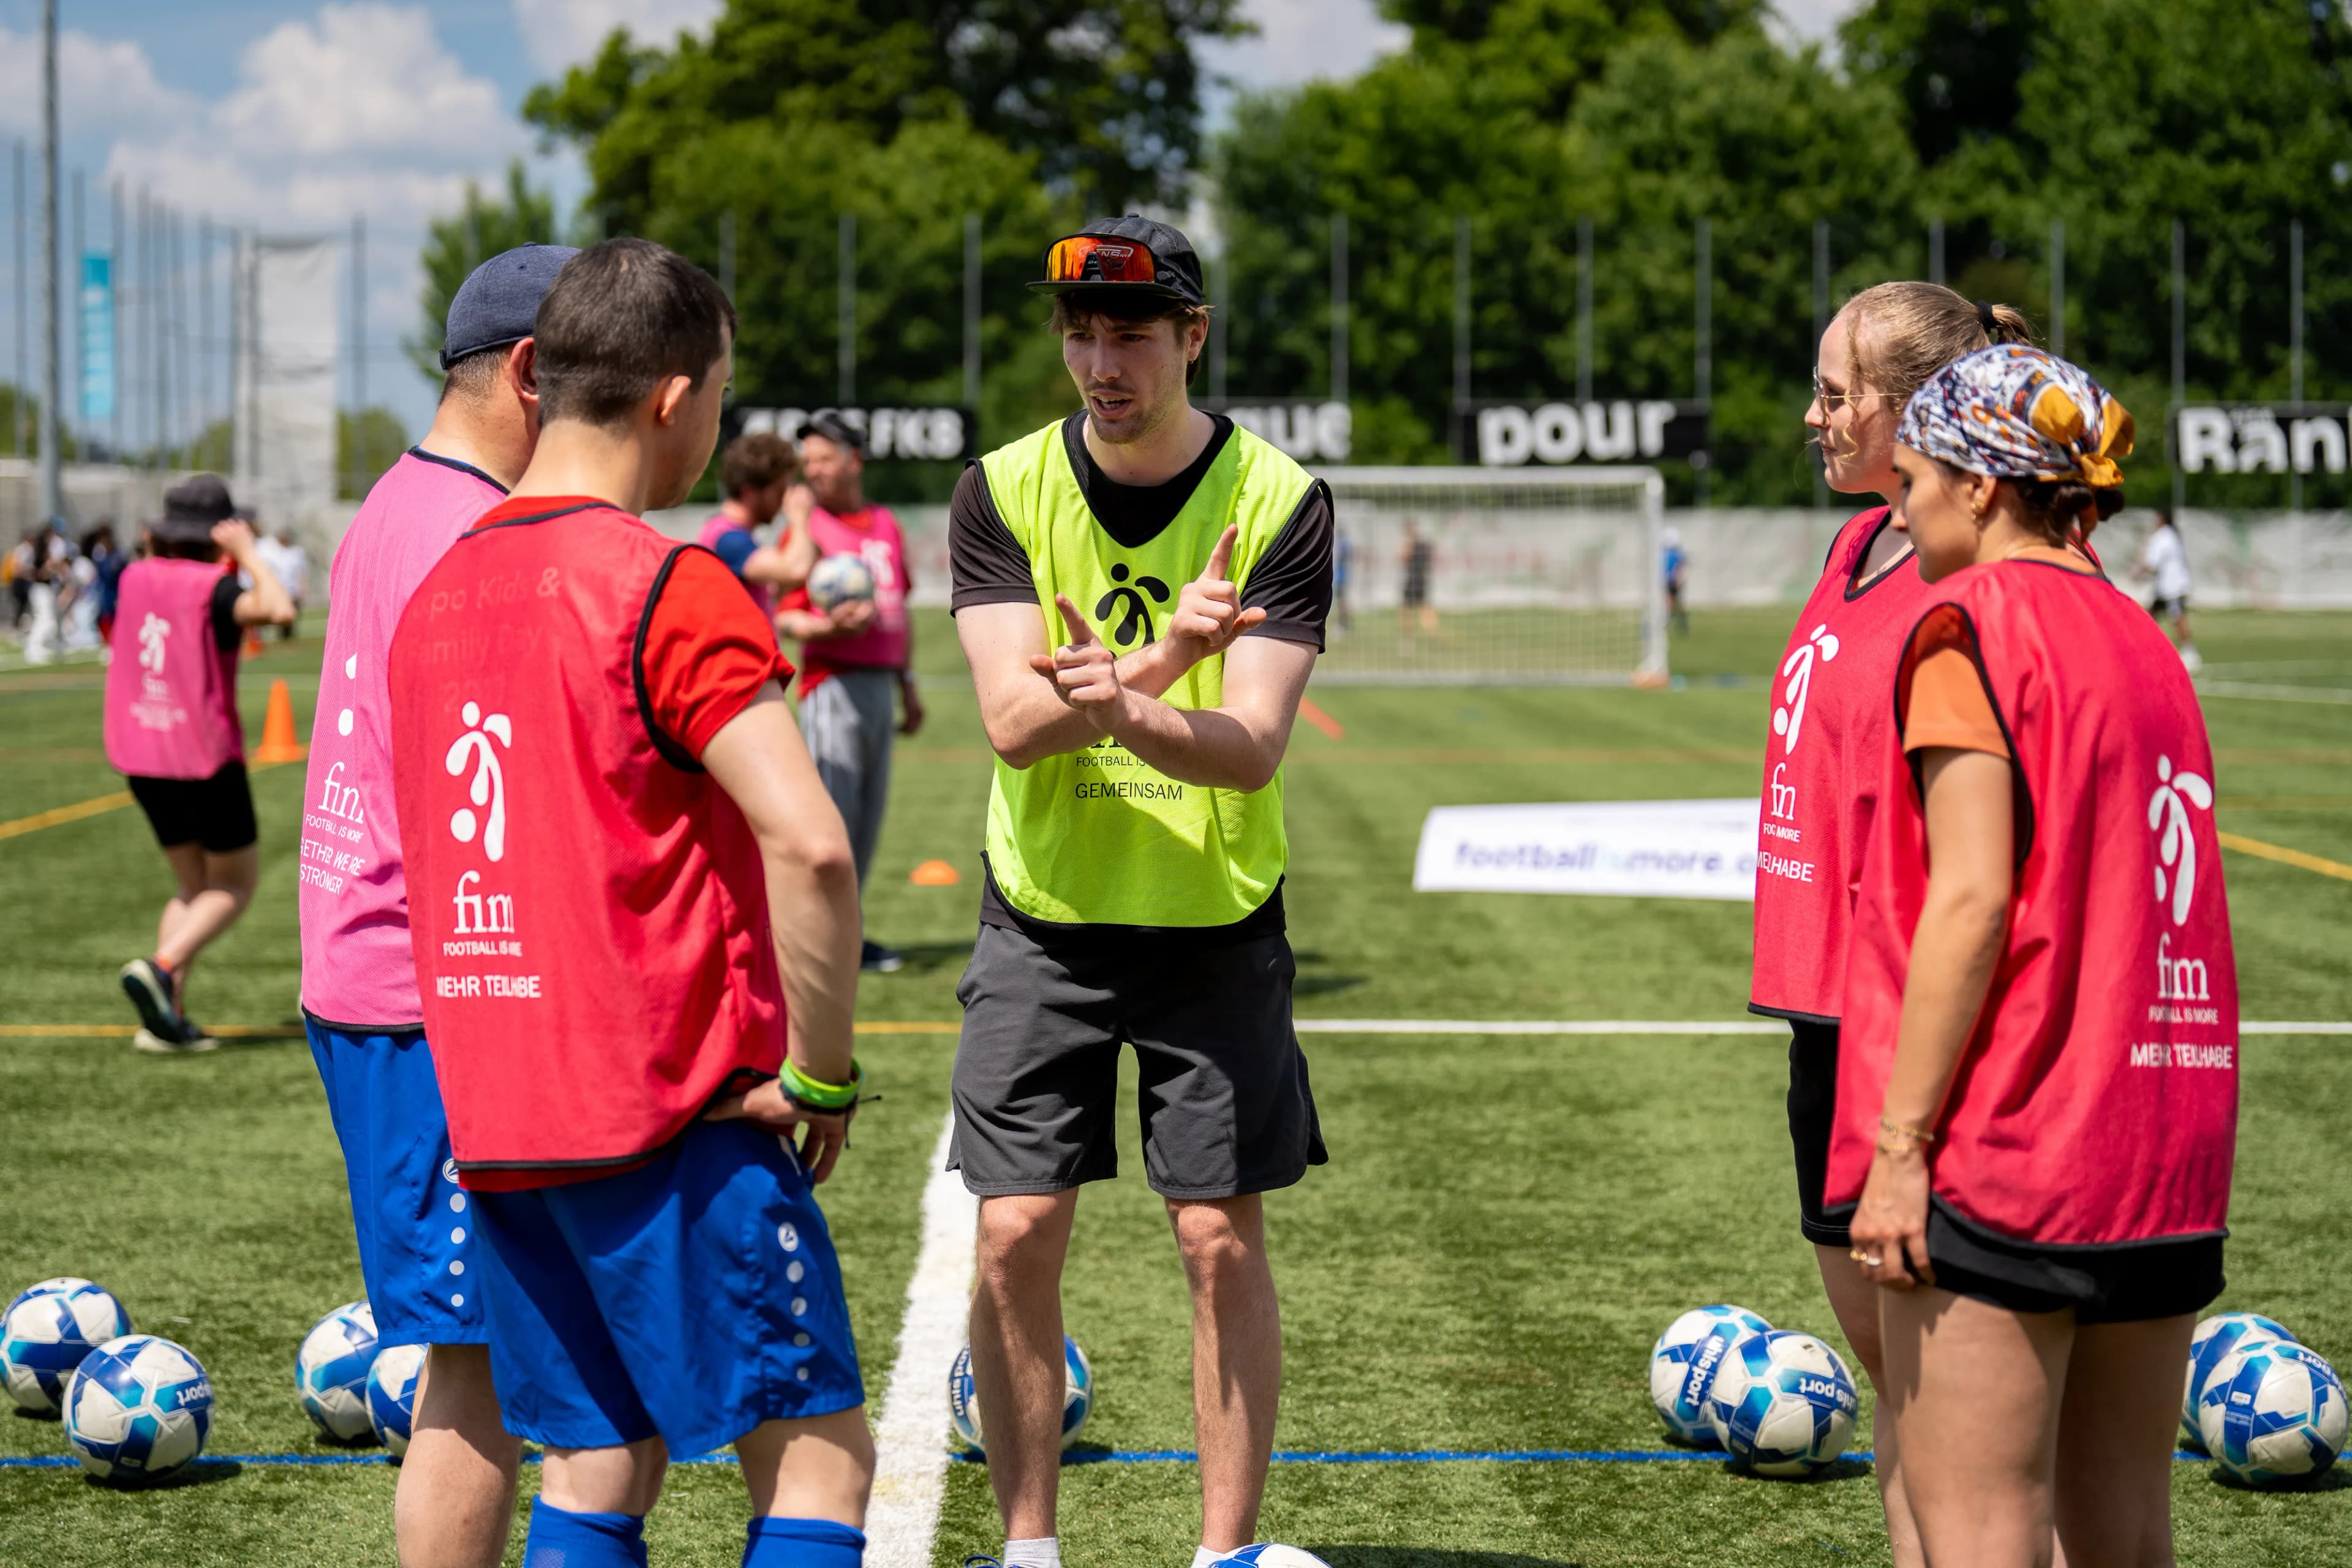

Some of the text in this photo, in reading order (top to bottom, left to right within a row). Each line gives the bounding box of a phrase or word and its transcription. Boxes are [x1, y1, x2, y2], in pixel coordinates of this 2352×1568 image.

[1478, 400, 1677, 466] pour
[535, 567, 560, 598] &
[1076, 755, 1133, 767] FOOTBALL
[1075, 782, 1182, 801] GEMEINSAM
